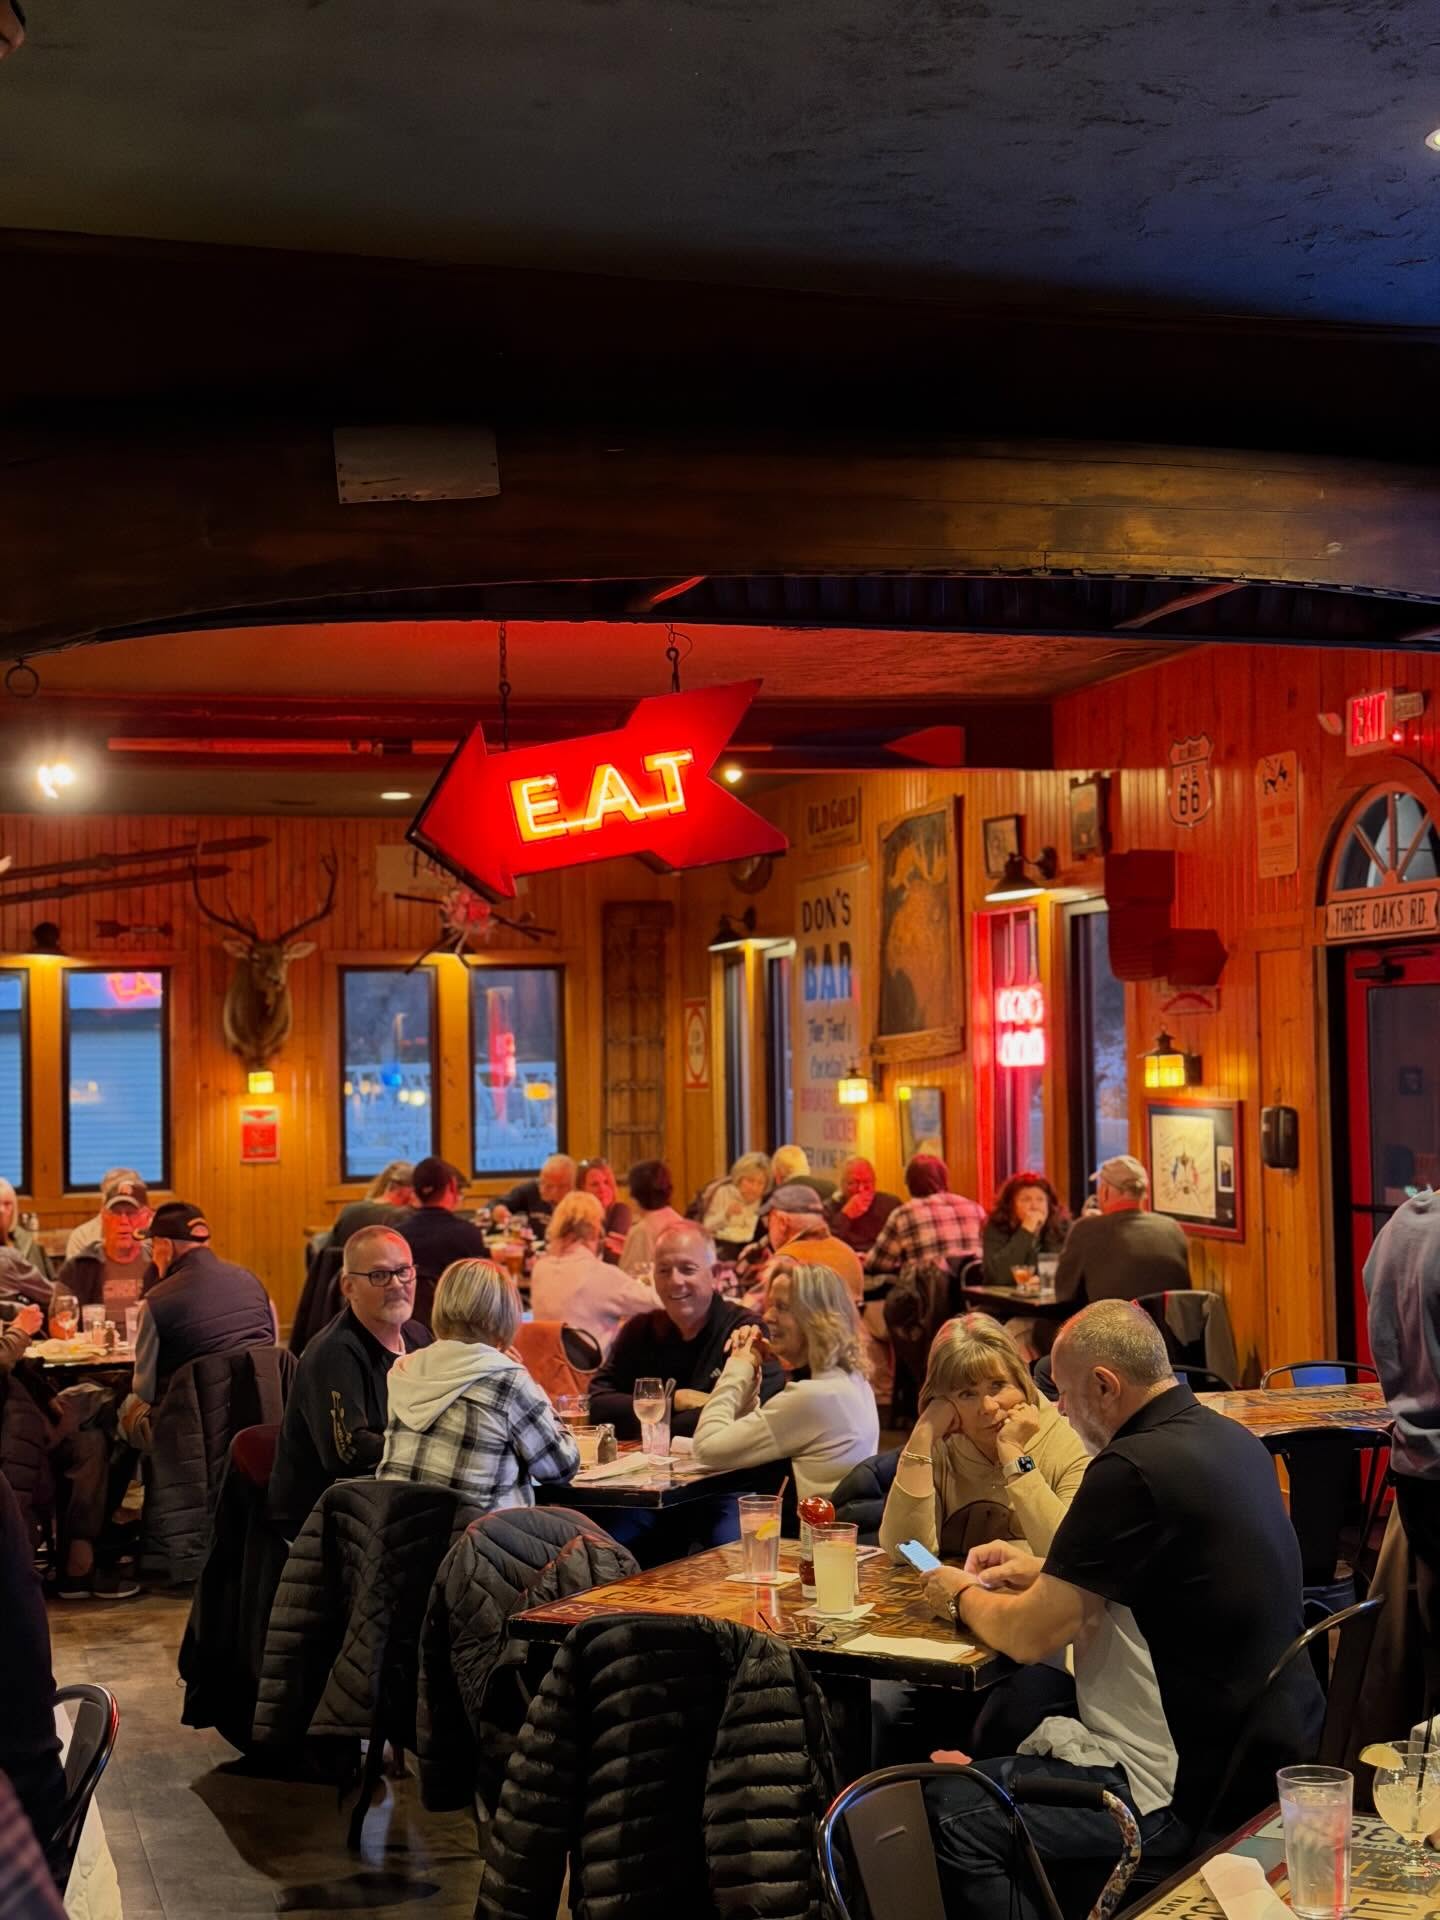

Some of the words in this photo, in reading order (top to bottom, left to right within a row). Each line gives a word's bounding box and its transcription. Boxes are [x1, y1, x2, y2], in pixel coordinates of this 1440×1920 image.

[1352, 691, 1387, 746] EXIT
[507, 748, 694, 844] EAT
[1179, 780, 1200, 815] 66
[802, 888, 852, 933] DON'S
[1335, 904, 1367, 933] THREE
[1373, 900, 1404, 929] OAKS
[804, 941, 852, 1001] BAR
[1154, 1895, 1193, 1916] TRUCK
